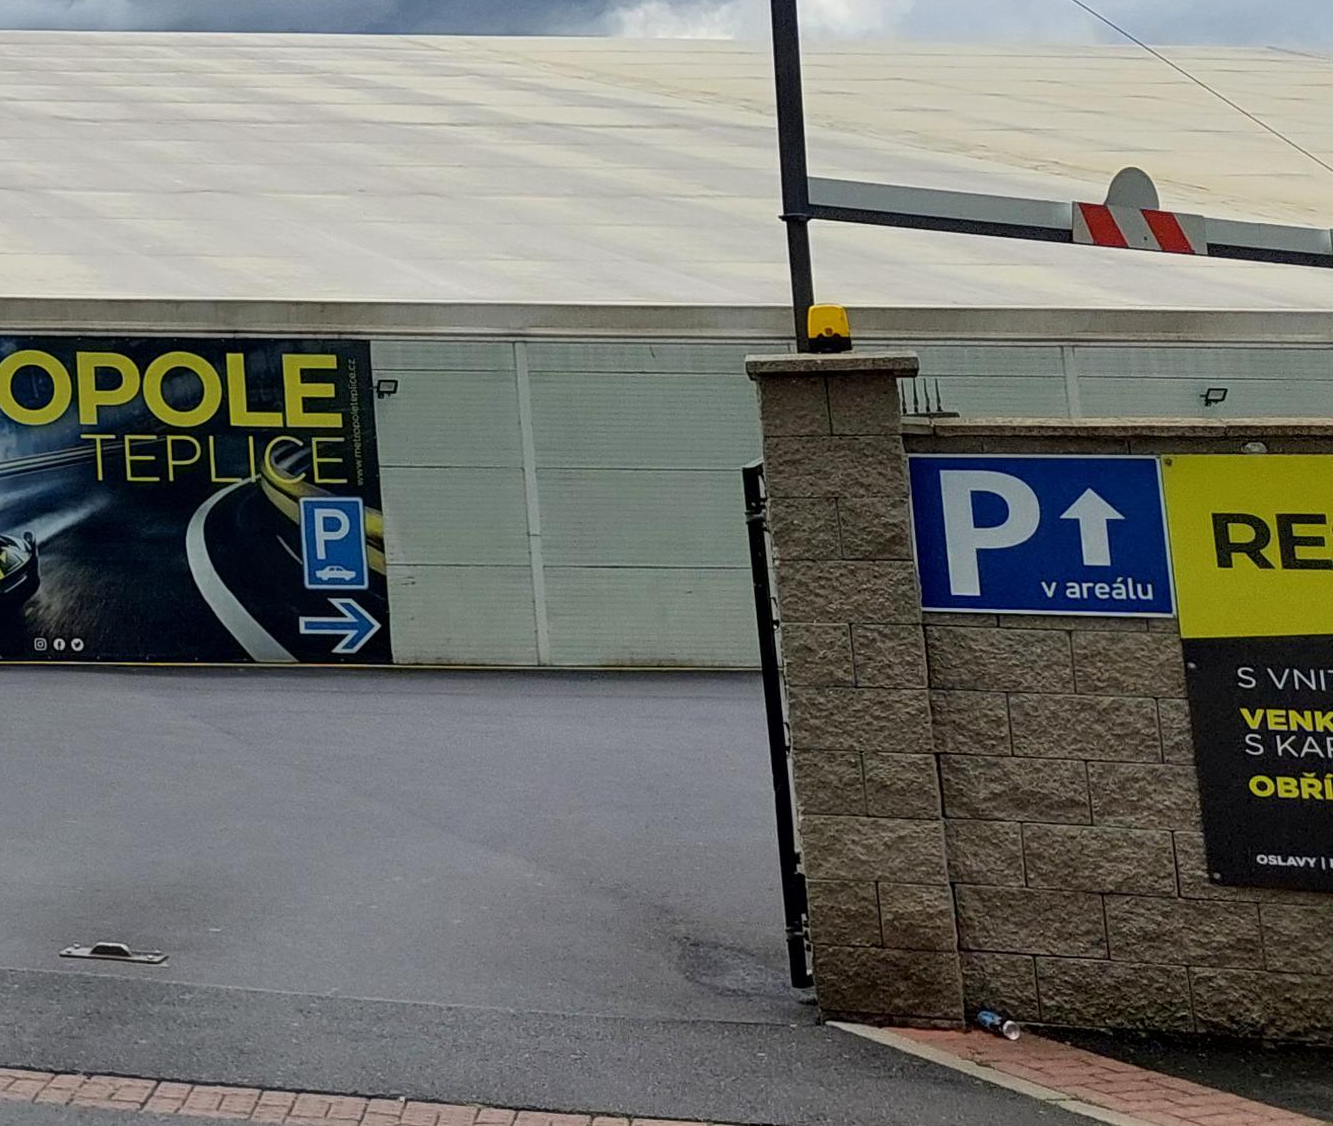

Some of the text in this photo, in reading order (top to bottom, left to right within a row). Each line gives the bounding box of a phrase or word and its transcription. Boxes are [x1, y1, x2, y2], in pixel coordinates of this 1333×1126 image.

[80, 434, 348, 483] TEPLICE
[313, 508, 350, 560] P
[939, 470, 1041, 596] P
[1211, 512, 1333, 570] RE
[1042, 577, 1154, 600] v areálu
[1237, 667, 1256, 688] S
[1245, 734, 1264, 755] S
[1256, 854, 1317, 868] OSLAVY
